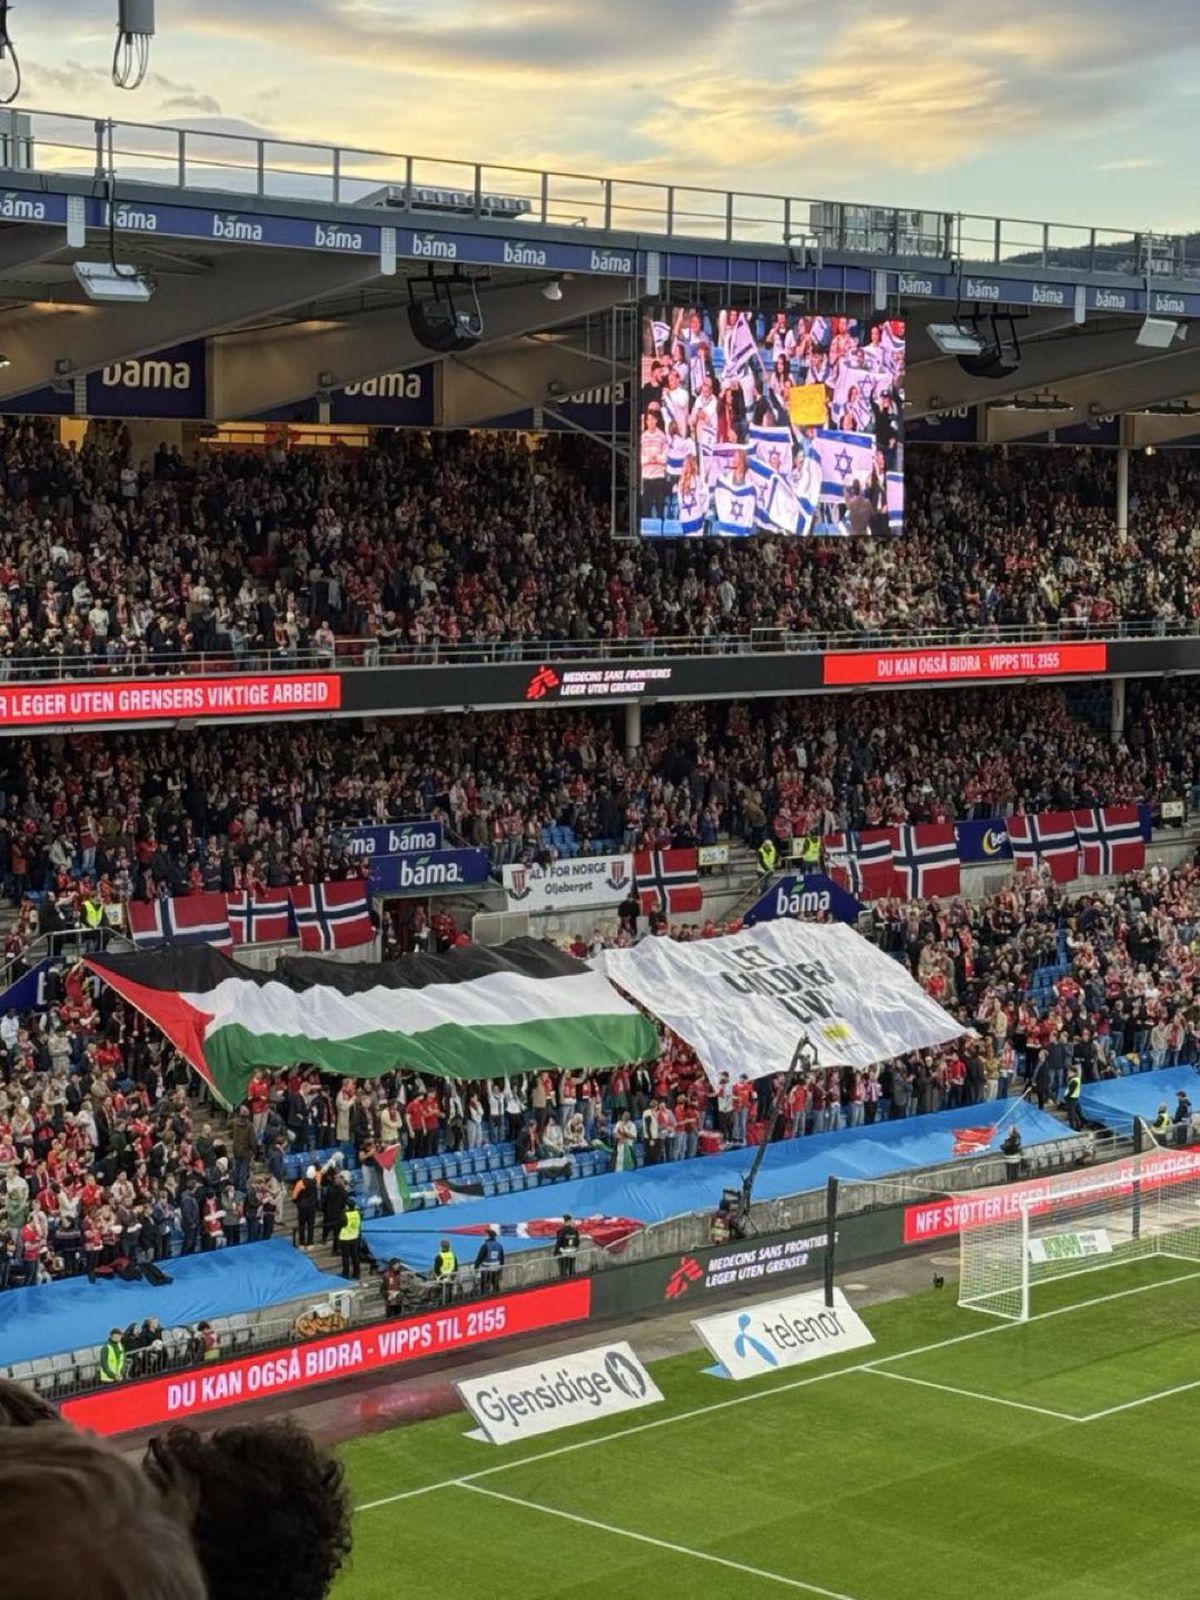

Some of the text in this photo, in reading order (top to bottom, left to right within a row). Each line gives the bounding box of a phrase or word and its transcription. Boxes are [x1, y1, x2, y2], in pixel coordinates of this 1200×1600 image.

[0, 199, 45, 219] ama
[213, 214, 263, 241] bama
[315, 229, 362, 250] bama
[413, 233, 457, 258] bama
[504, 242, 547, 266] bama
[591, 250, 631, 273] bama
[967, 280, 1000, 299] bama
[1032, 285, 1064, 304] bama
[1096, 290, 1127, 309] bama
[1155, 294, 1186, 314] bama
[877, 659, 894, 677] DU
[895, 657, 917, 676] KAN
[918, 652, 948, 674] OGSÅ
[950, 655, 981, 673] BIDRA
[989, 653, 1020, 671] VIPPS
[1022, 653, 1036, 669] TIL
[1037, 651, 1060, 669] 2155
[11, 692, 66, 717] LEGER
[70, 689, 114, 713] UTEN
[119, 686, 204, 712] GRENSERS
[207, 683, 270, 707] VIKTIGE
[273, 681, 329, 704] ARBEID
[389, 830, 436, 852] bama
[401, 860, 458, 887] bama
[550, 864, 571, 879] FOR
[572, 862, 607, 877] NORGE
[776, 887, 831, 915] bama
[916, 1208, 942, 1234] NFF
[758, 1244, 783, 1261] SANS
[705, 1254, 808, 1288] LEGER UTEN GRENSER
[762, 1309, 847, 1350] telenor
[167, 1379, 196, 1411] DU
[202, 1369, 242, 1403] KAN
[247, 1348, 301, 1391] OGSÅ
[305, 1339, 362, 1376] BIDRA
[378, 1323, 432, 1358] VIPPS
[436, 1317, 463, 1343] TIL
[467, 1306, 506, 1337] 2155
[477, 1369, 612, 1427] Gjensidige
